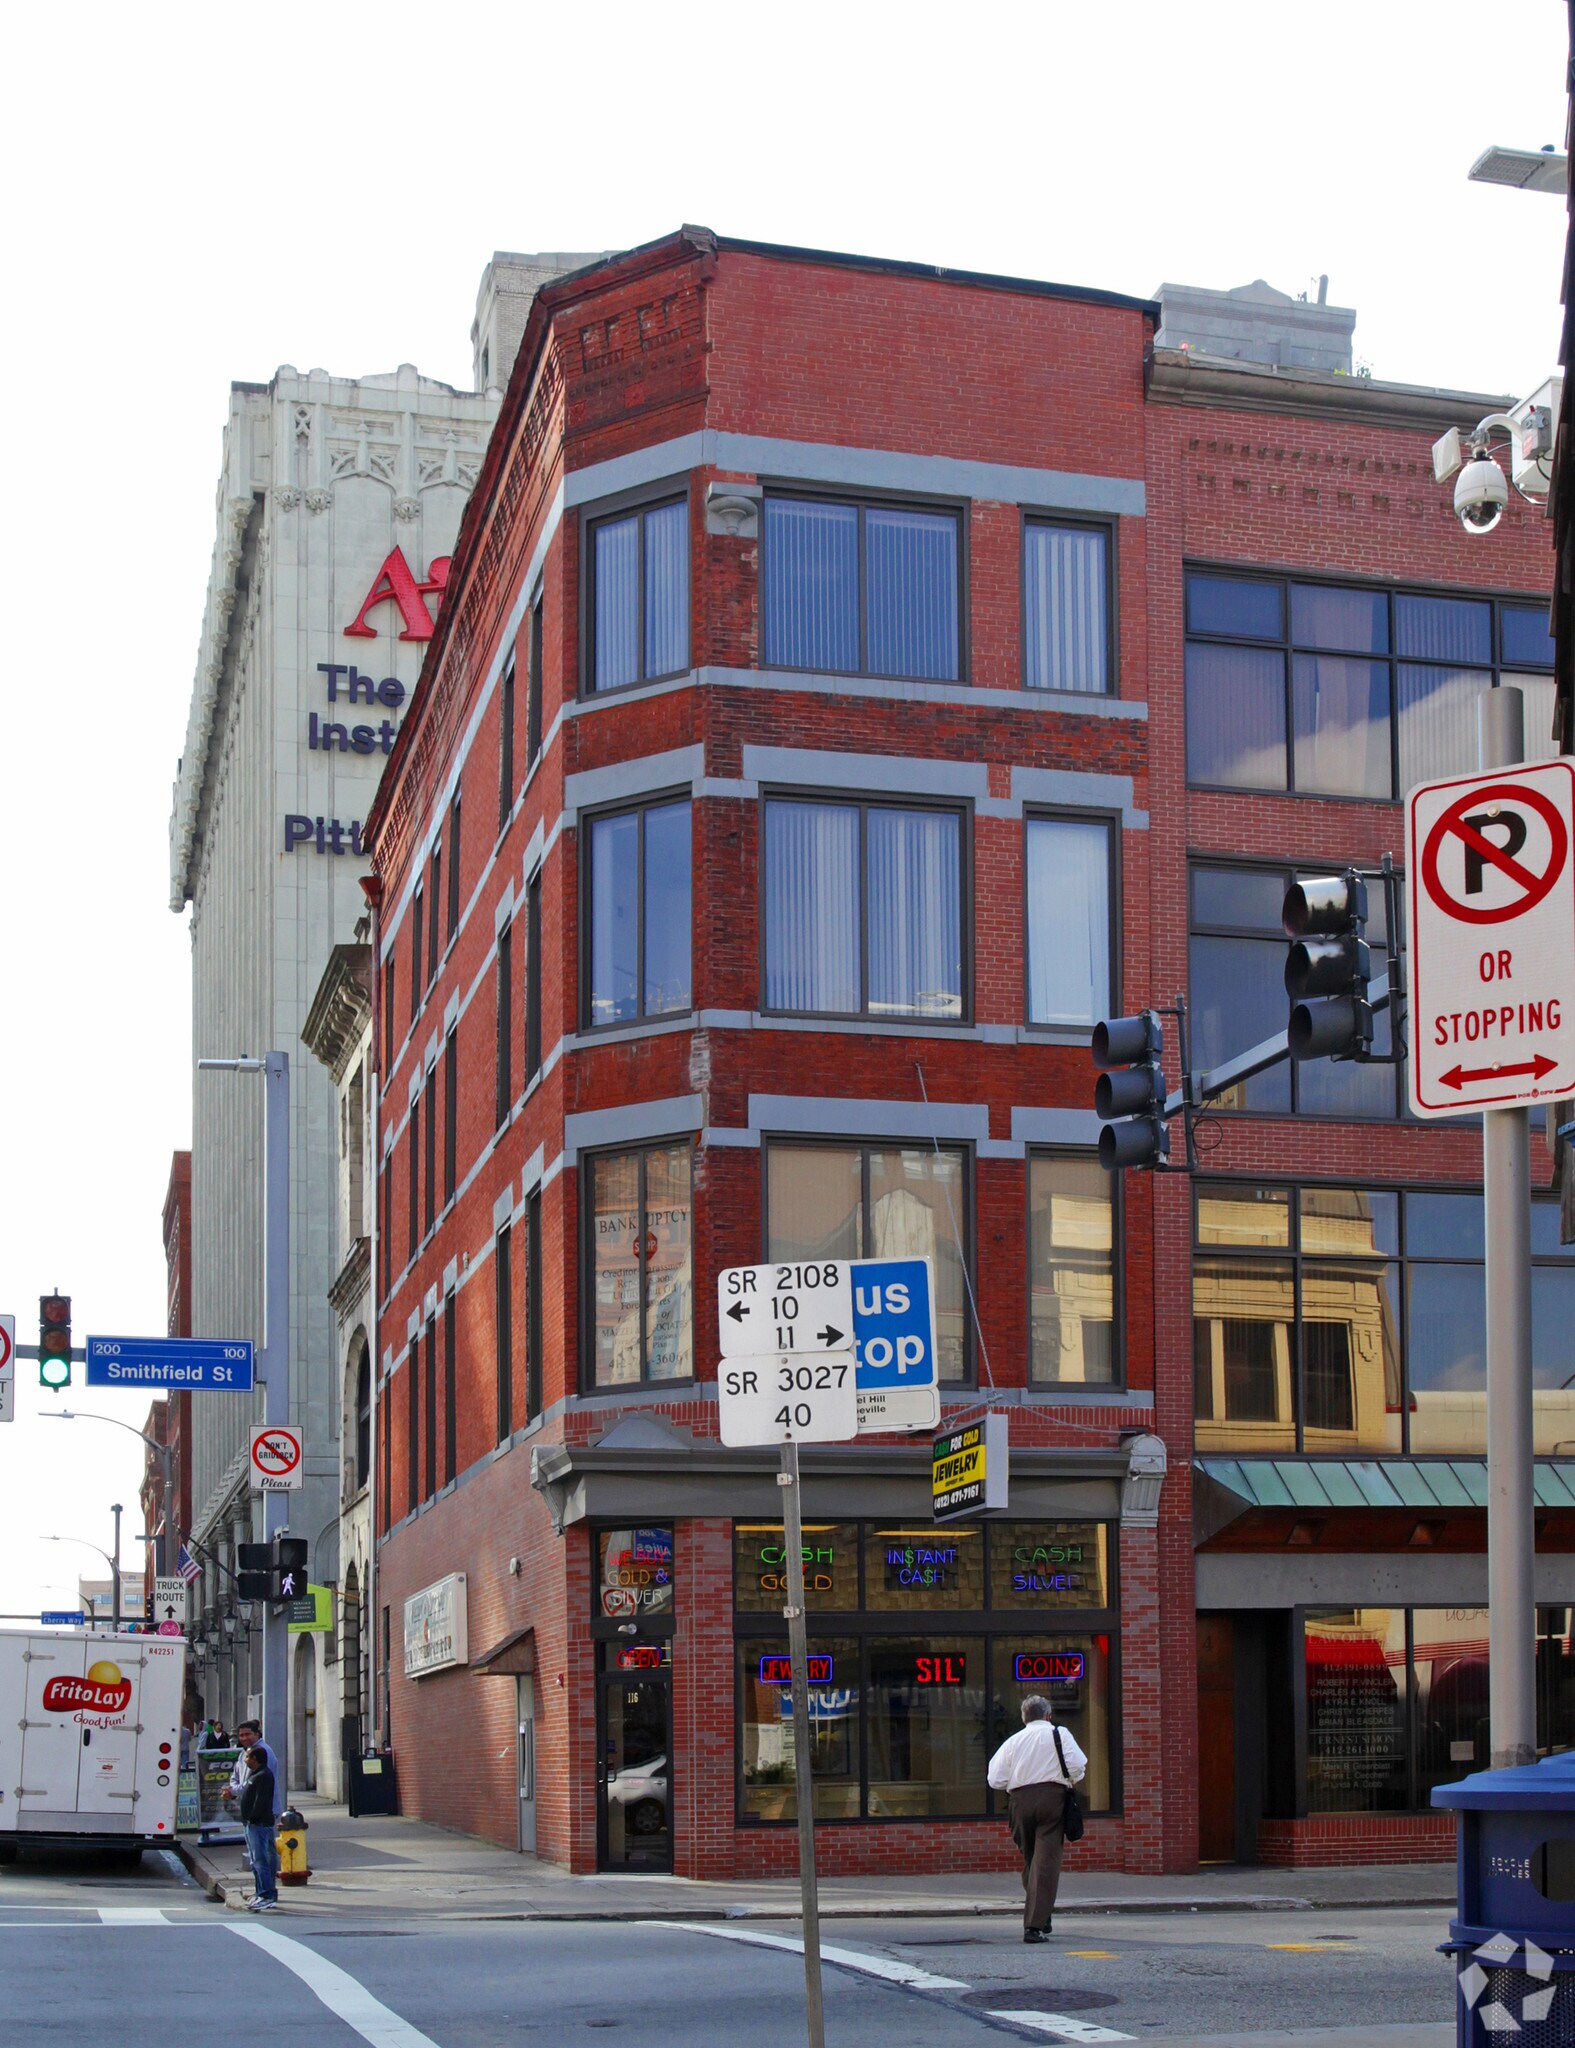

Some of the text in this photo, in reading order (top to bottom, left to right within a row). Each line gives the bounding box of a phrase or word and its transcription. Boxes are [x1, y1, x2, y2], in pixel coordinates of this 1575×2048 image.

[343, 544, 452, 642] A
[316, 662, 406, 707] The
[308, 712, 403, 755] Inst
[284, 814, 367, 857] Pitt
[1479, 949, 1513, 983] OR
[1434, 998, 1563, 1046] STOPPING
[599, 1208, 689, 1233] BANKUPTCY
[634, 1240, 657, 1252] SOP
[602, 1268, 638, 1279] Creditor
[726, 1263, 840, 1295] SR 2108
[771, 1296, 799, 1320] 10
[855, 1282, 911, 1317] us
[776, 1325, 795, 1349] 11
[95, 1343, 246, 1360] 200 100
[855, 1333, 925, 1375] top
[107, 1362, 233, 1382] Smithfield St
[726, 1365, 848, 1395] SR 3027
[857, 1395, 886, 1404] el Hill
[775, 1403, 811, 1428] 40
[857, 1415, 866, 1424] rd
[935, 1428, 979, 1457] CASH FOR GOLD
[934, 1449, 980, 1484] JEWELRY
[260, 1477, 293, 1488] Please
[934, 1484, 980, 1510] (412) 471-7161
[608, 1549, 668, 1567] WE BUY
[1014, 1546, 1083, 1562] CASH
[608, 1567, 669, 1586] GOLD &
[156, 1581, 185, 1592] TRUCK
[156, 1592, 185, 1603] ROUTE
[612, 1588, 664, 1606] SILVER
[43, 1616, 83, 1625] Cherry Way
[1308, 1633, 1341, 1644] LAW
[148, 1648, 175, 1656] R42251
[616, 1649, 661, 1669] OPEN
[763, 1659, 829, 1680] JEWRY
[915, 1656, 965, 1683] SIL
[1018, 1656, 1083, 1678] COINS
[1317, 1678, 1349, 1687] ROBERT
[627, 1692, 639, 1703] 116
[1310, 1688, 1348, 1697] CHARLES
[1325, 1698, 1350, 1706] KYRA
[1317, 1708, 1353, 1716] CHRISTY
[73, 1713, 126, 1730] Good fun!
[1318, 1717, 1344, 1726] BRIAN
[1318, 1735, 1360, 1745] ERNEST
[202, 1752, 238, 1760] CAS
[1325, 1745, 1389, 1754] 412-261-1000
[208, 1761, 236, 1770] FO
[204, 1771, 232, 1781] GO
